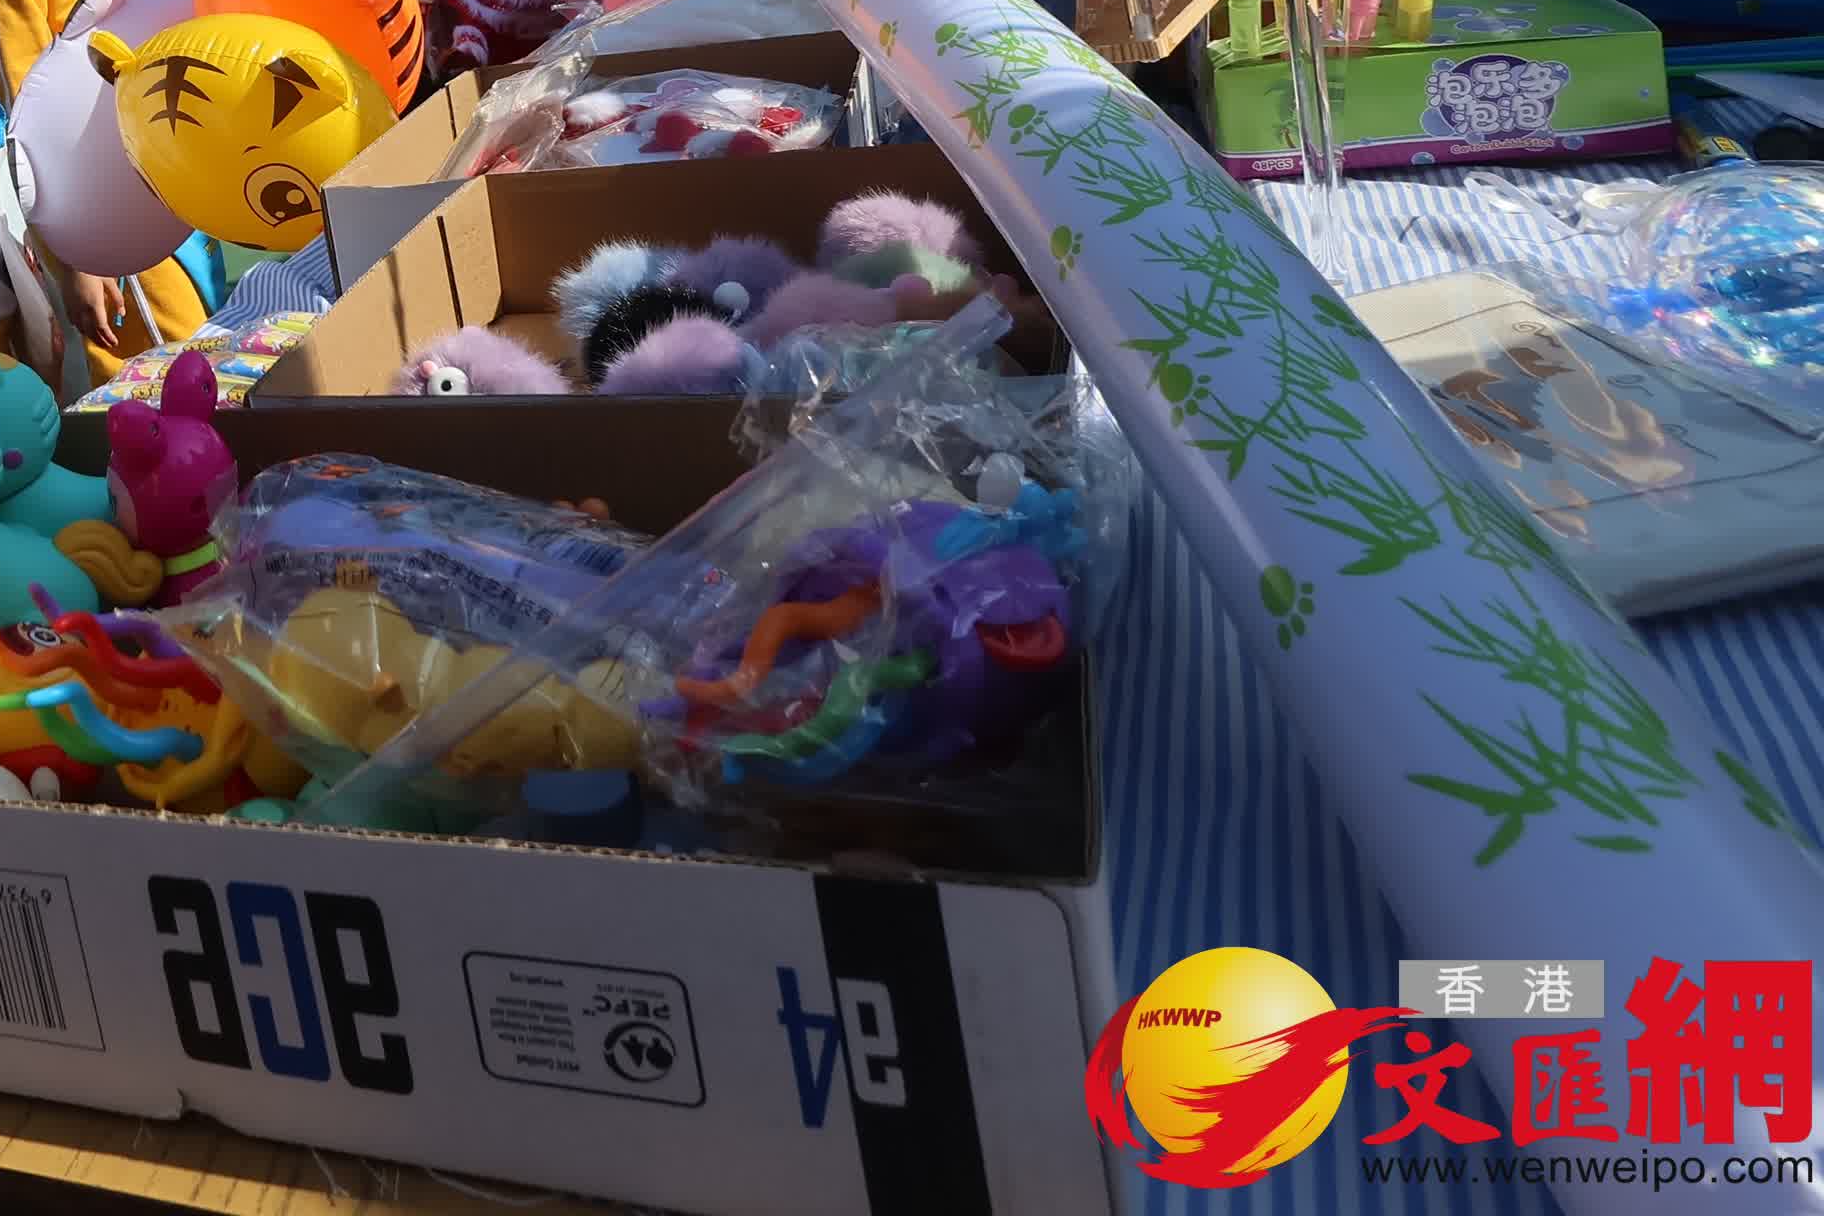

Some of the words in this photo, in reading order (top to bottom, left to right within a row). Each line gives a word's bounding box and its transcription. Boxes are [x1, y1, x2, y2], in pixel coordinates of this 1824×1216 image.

[1426, 60, 1562, 107] 泡乐多
[1451, 94, 1548, 134] 泡泡
[147, 874, 414, 1095] ace
